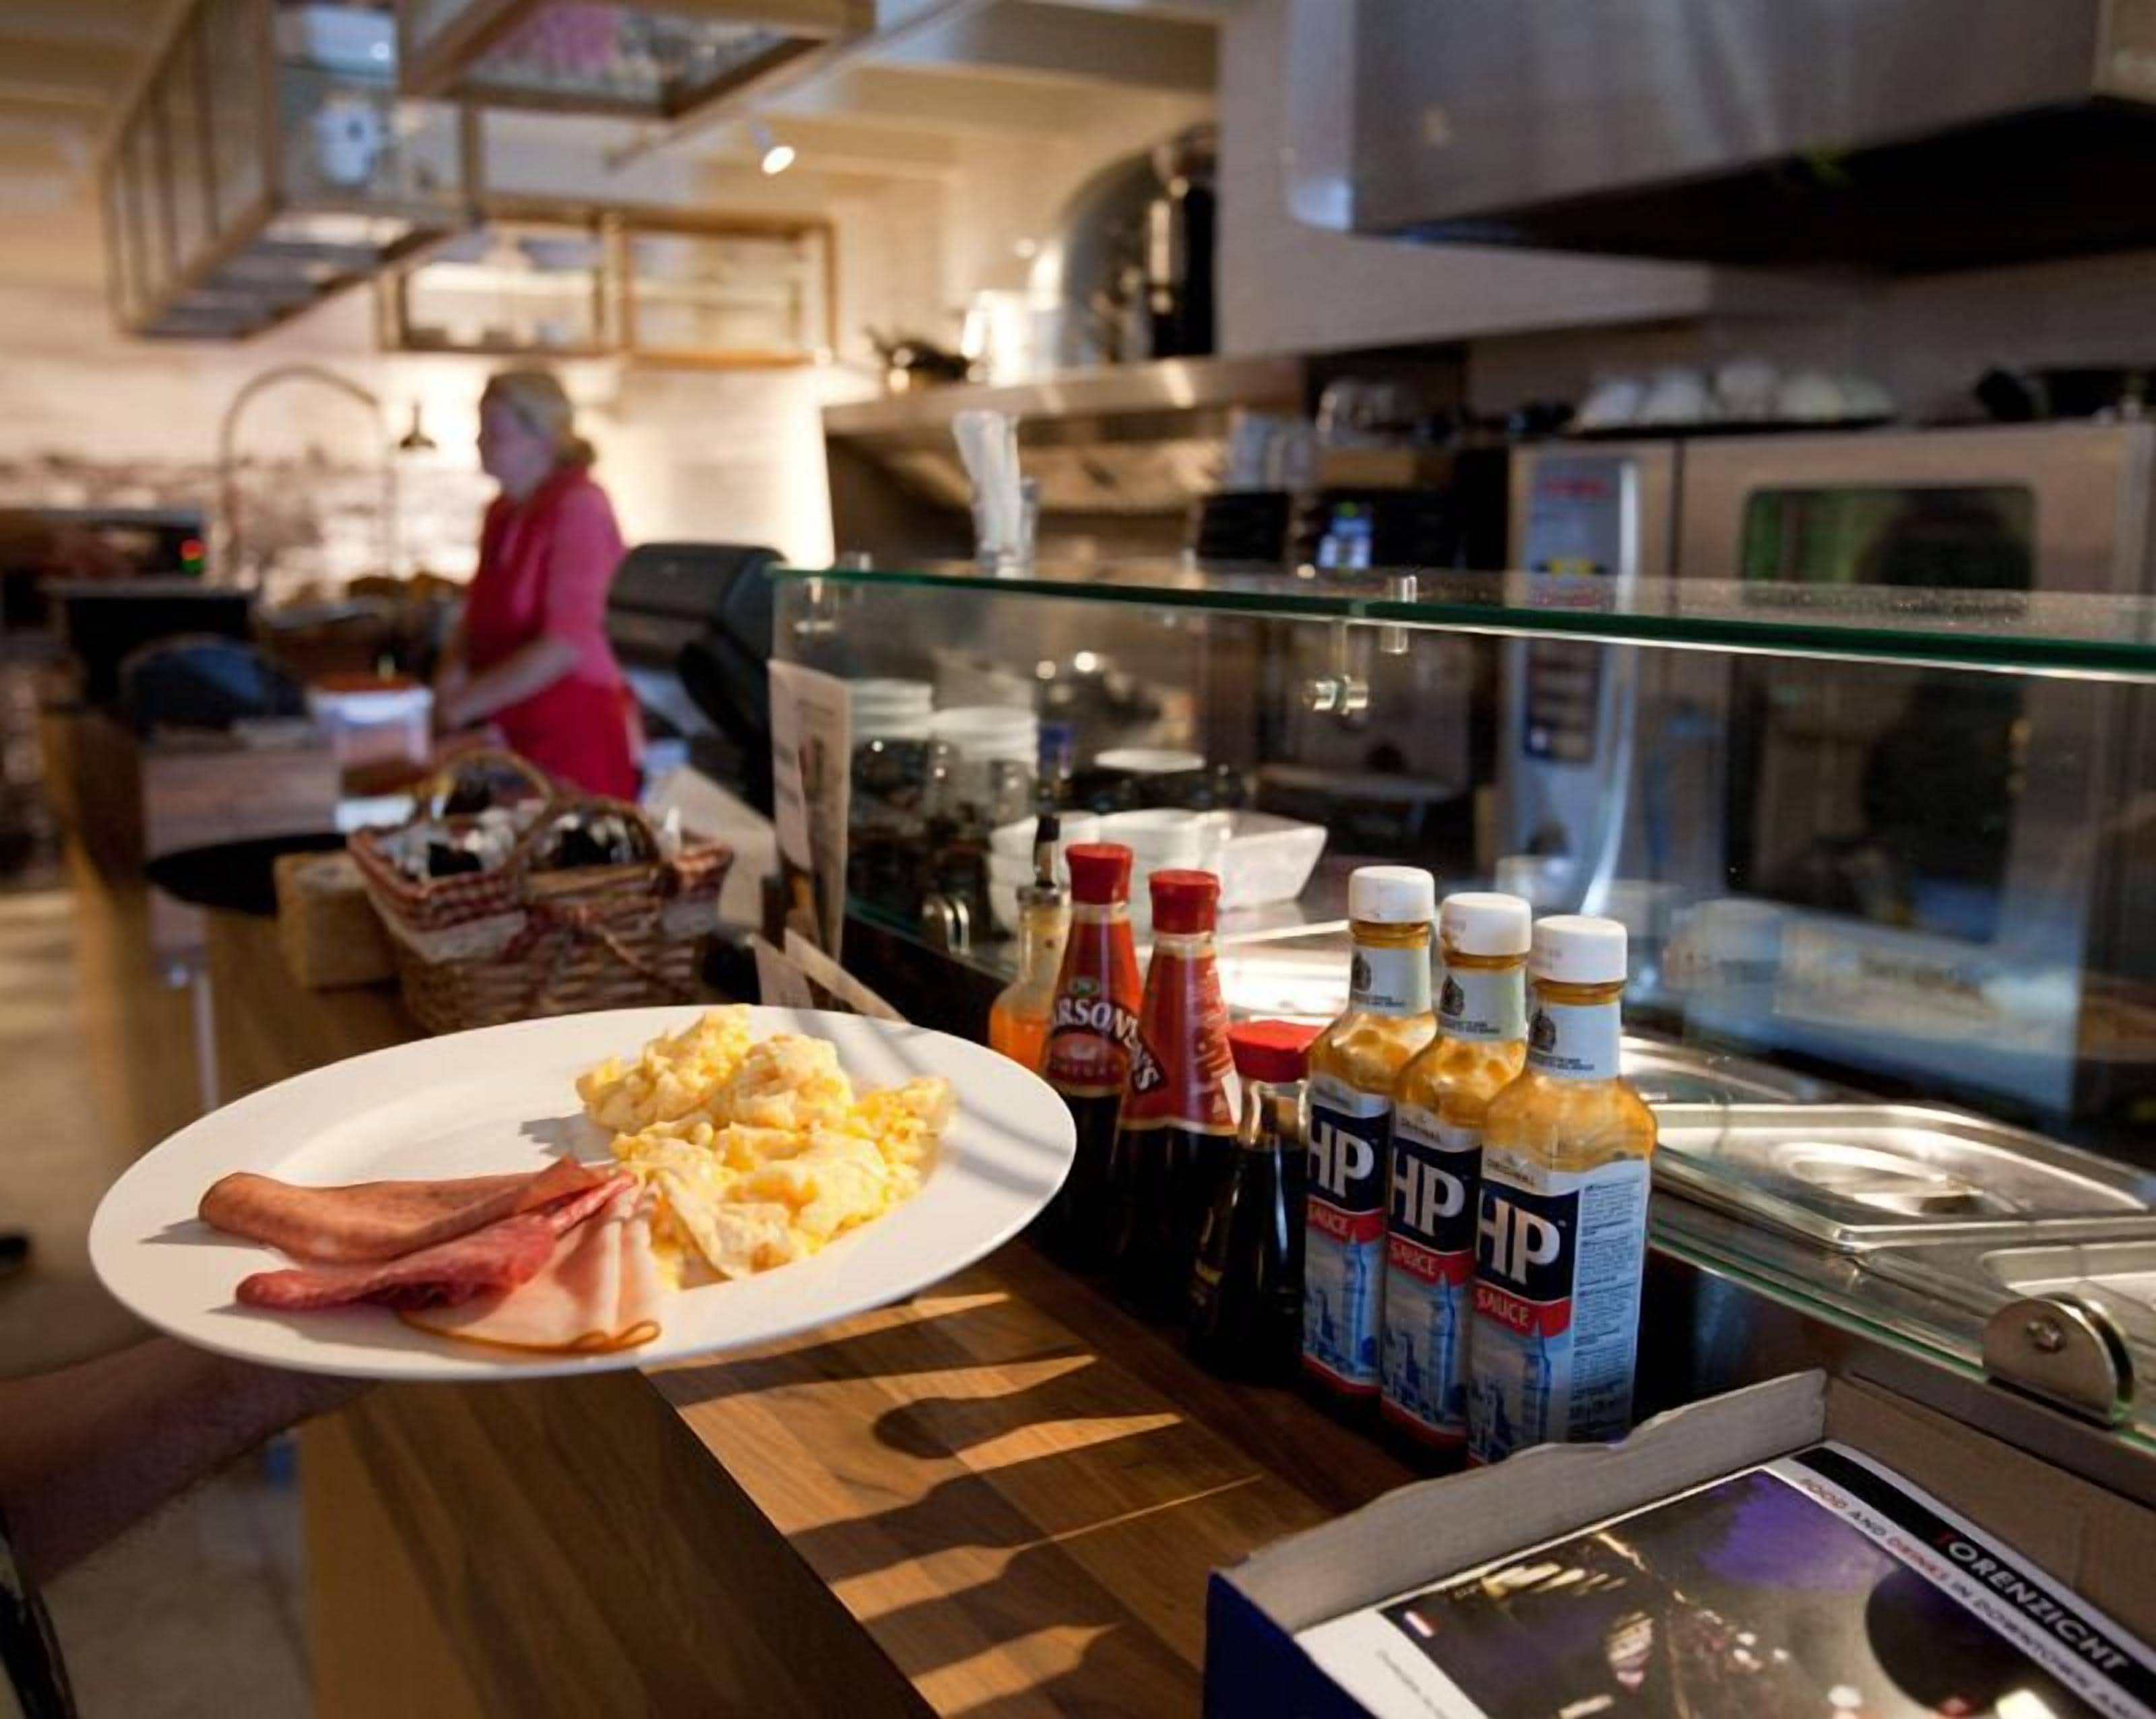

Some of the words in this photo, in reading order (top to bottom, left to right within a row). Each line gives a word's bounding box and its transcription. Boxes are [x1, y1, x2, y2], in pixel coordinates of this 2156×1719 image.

[1307, 1121, 1374, 1198] HP
[1391, 1146, 1465, 1237] HP
[1476, 1187, 1560, 1285] HP
[1476, 1287, 1530, 1327] SAUCE
